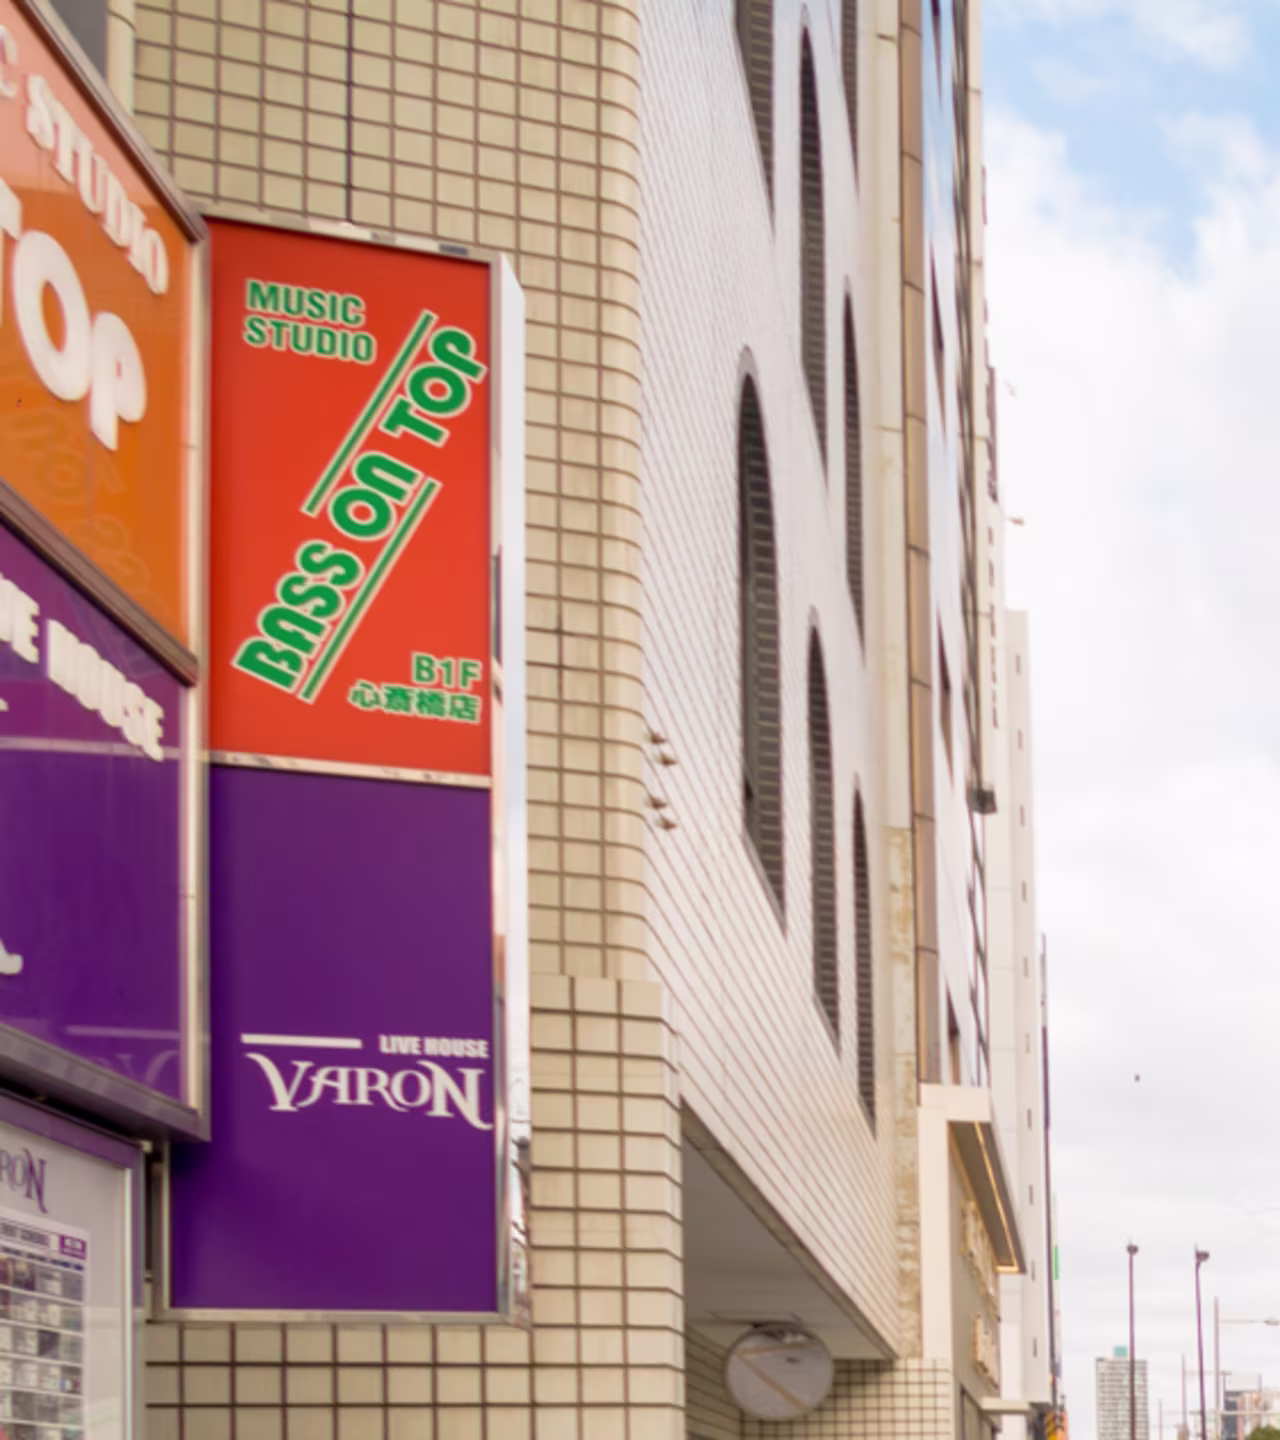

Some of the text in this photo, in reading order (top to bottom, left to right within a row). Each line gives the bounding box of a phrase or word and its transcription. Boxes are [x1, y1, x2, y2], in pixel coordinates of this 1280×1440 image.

[27, 73, 169, 295] STUDIO
[0, 178, 147, 451] OP
[246, 279, 365, 326] MUSIC
[243, 316, 375, 364] STUDIO
[231, 539, 363, 691] BASS
[379, 326, 488, 446] TOP
[411, 651, 483, 691] B1F
[379, 1034, 490, 1059] LIVE HOUSE
[245, 1052, 494, 1131] VARON
